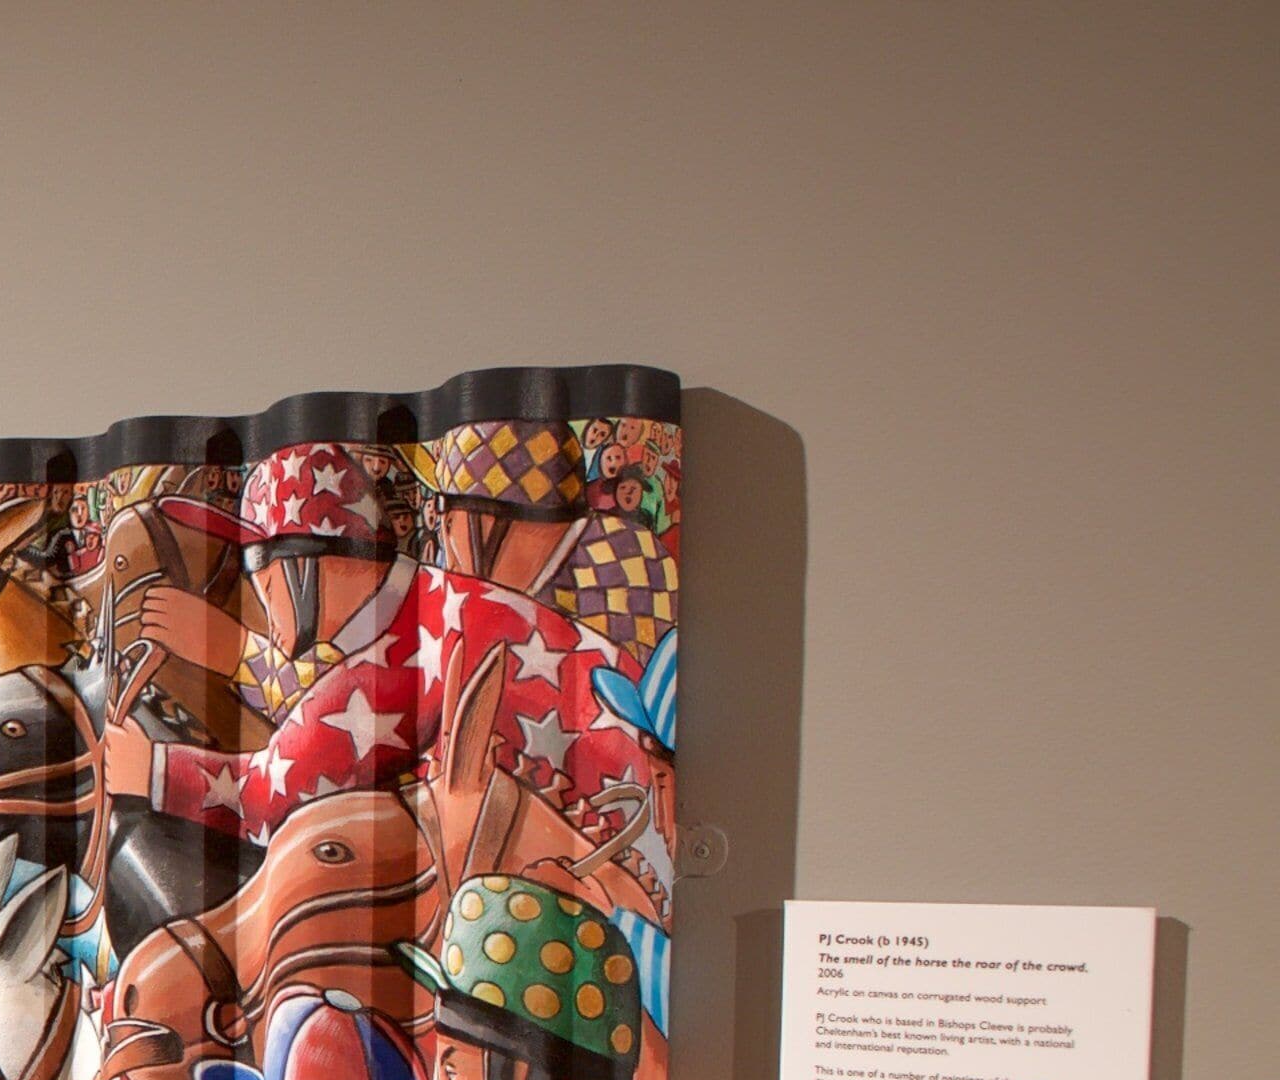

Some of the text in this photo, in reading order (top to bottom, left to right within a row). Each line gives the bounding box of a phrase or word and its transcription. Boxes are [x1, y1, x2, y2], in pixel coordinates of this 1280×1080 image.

[819, 934, 929, 949] PJ Crook (b 1945)
[819, 953, 1088, 973] The smell of the horse the roar of the crowd.
[818, 968, 843, 978] 2006
[816, 987, 849, 998] Acrylic
[853, 989, 865, 997] on
[868, 990, 898, 999] canvas
[917, 992, 971, 1003] corrugated
[975, 994, 1003, 1003] wood
[816, 1013, 1073, 1036] PJ Crook who is based in Bishops Cleeve is probably
[816, 1026, 877, 1038] Cheltenham's
[881, 1030, 901, 1039] best
[905, 1031, 937, 1040] known
[940, 1032, 965, 1044] living
[1000, 1037, 1021, 1046] with
[1034, 1038, 1075, 1049] national
[815, 1041, 949, 1056] and international reputation.
[815, 1065, 834, 1075] This
[837, 1068, 844, 1076] is
[868, 1070, 877, 1078] of
[880, 1071, 885, 1079] a
[889, 1071, 925, 1080] number
